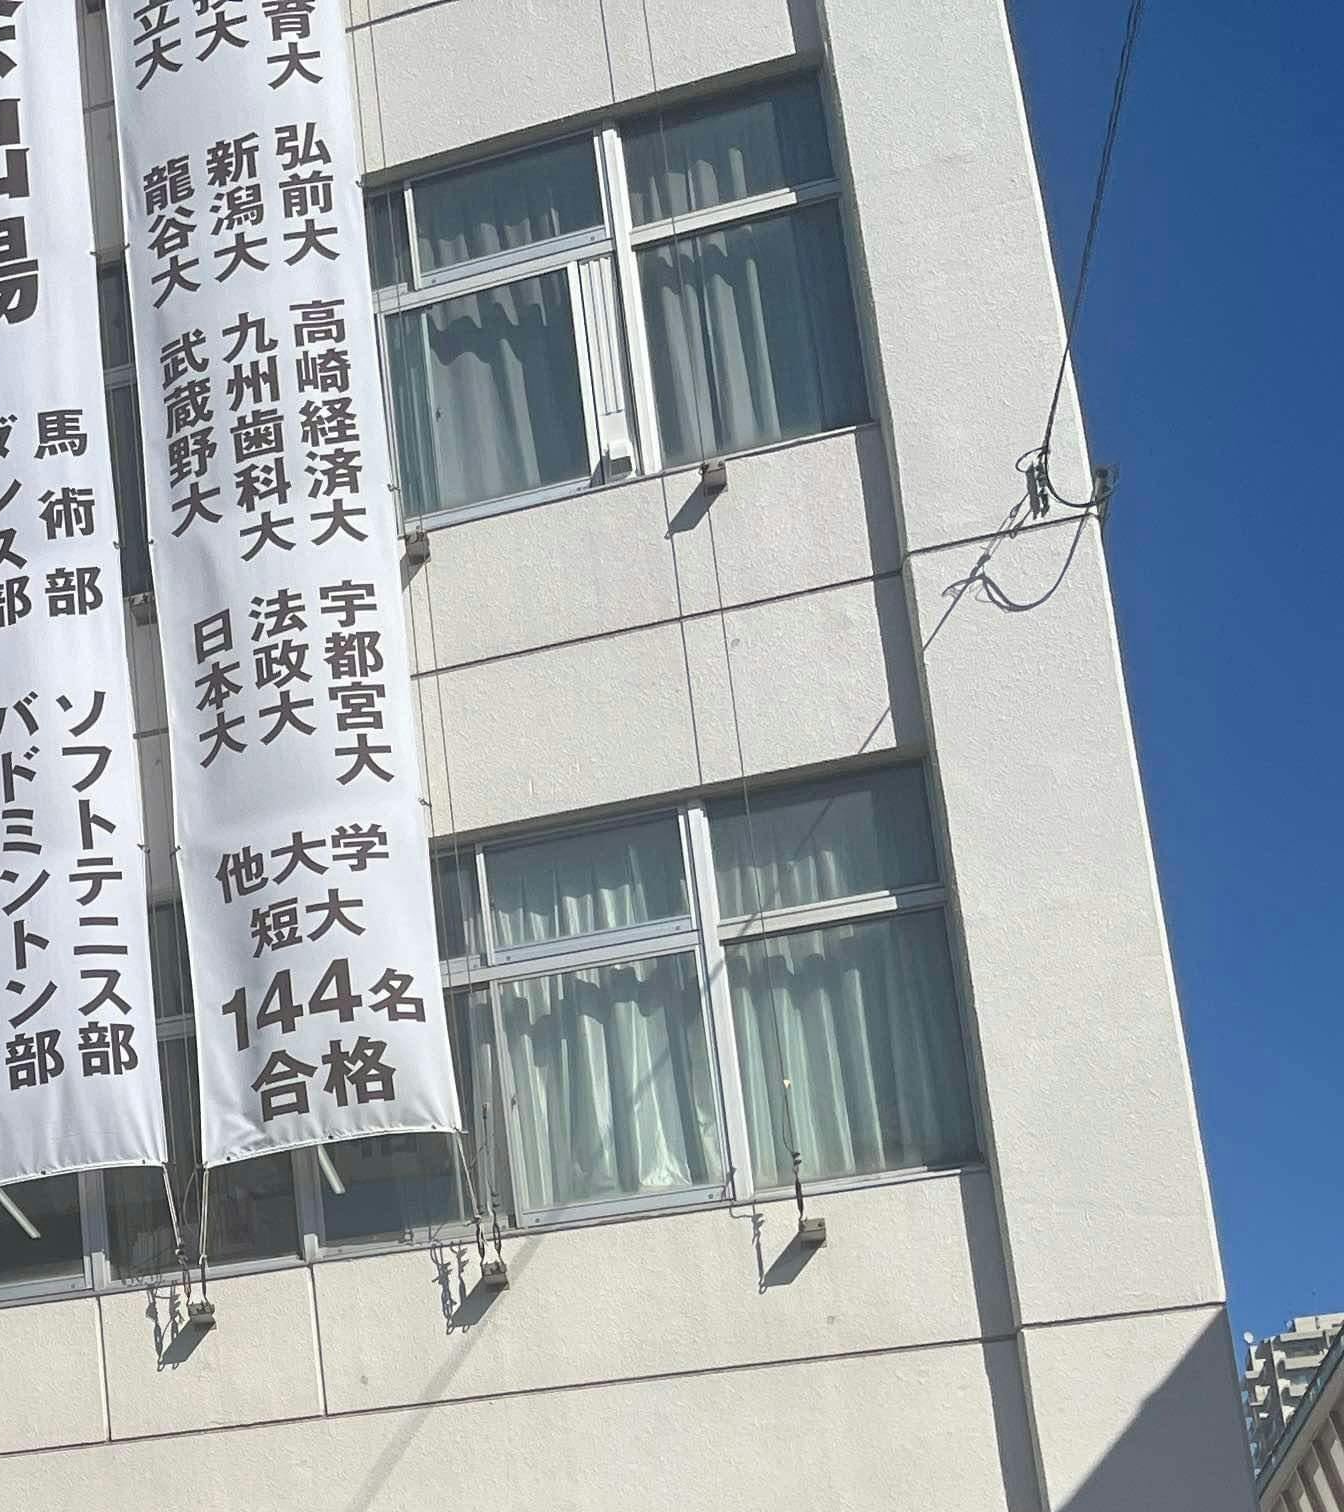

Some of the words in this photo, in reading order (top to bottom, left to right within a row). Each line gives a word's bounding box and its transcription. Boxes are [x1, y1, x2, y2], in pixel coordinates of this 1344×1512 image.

[144, 155, 201, 309] 龍谷大
[207, 132, 269, 282] 新潟大
[275, 123, 339, 266] 弘前大
[160, 329, 222, 537] 武蔵野大
[222, 312, 296, 561] 九州歯科大
[290, 299, 368, 545] 高崎経済大
[34, 410, 103, 616] 馬術部
[194, 608, 247, 768] 日本大
[249, 589, 316, 745] 法政大
[320, 580, 395, 785] 宇都宮大
[56, 691, 138, 1077] ソフトテニス部
[222, 958, 426, 1052] 144名
[251, 1035, 396, 1122] 合格
